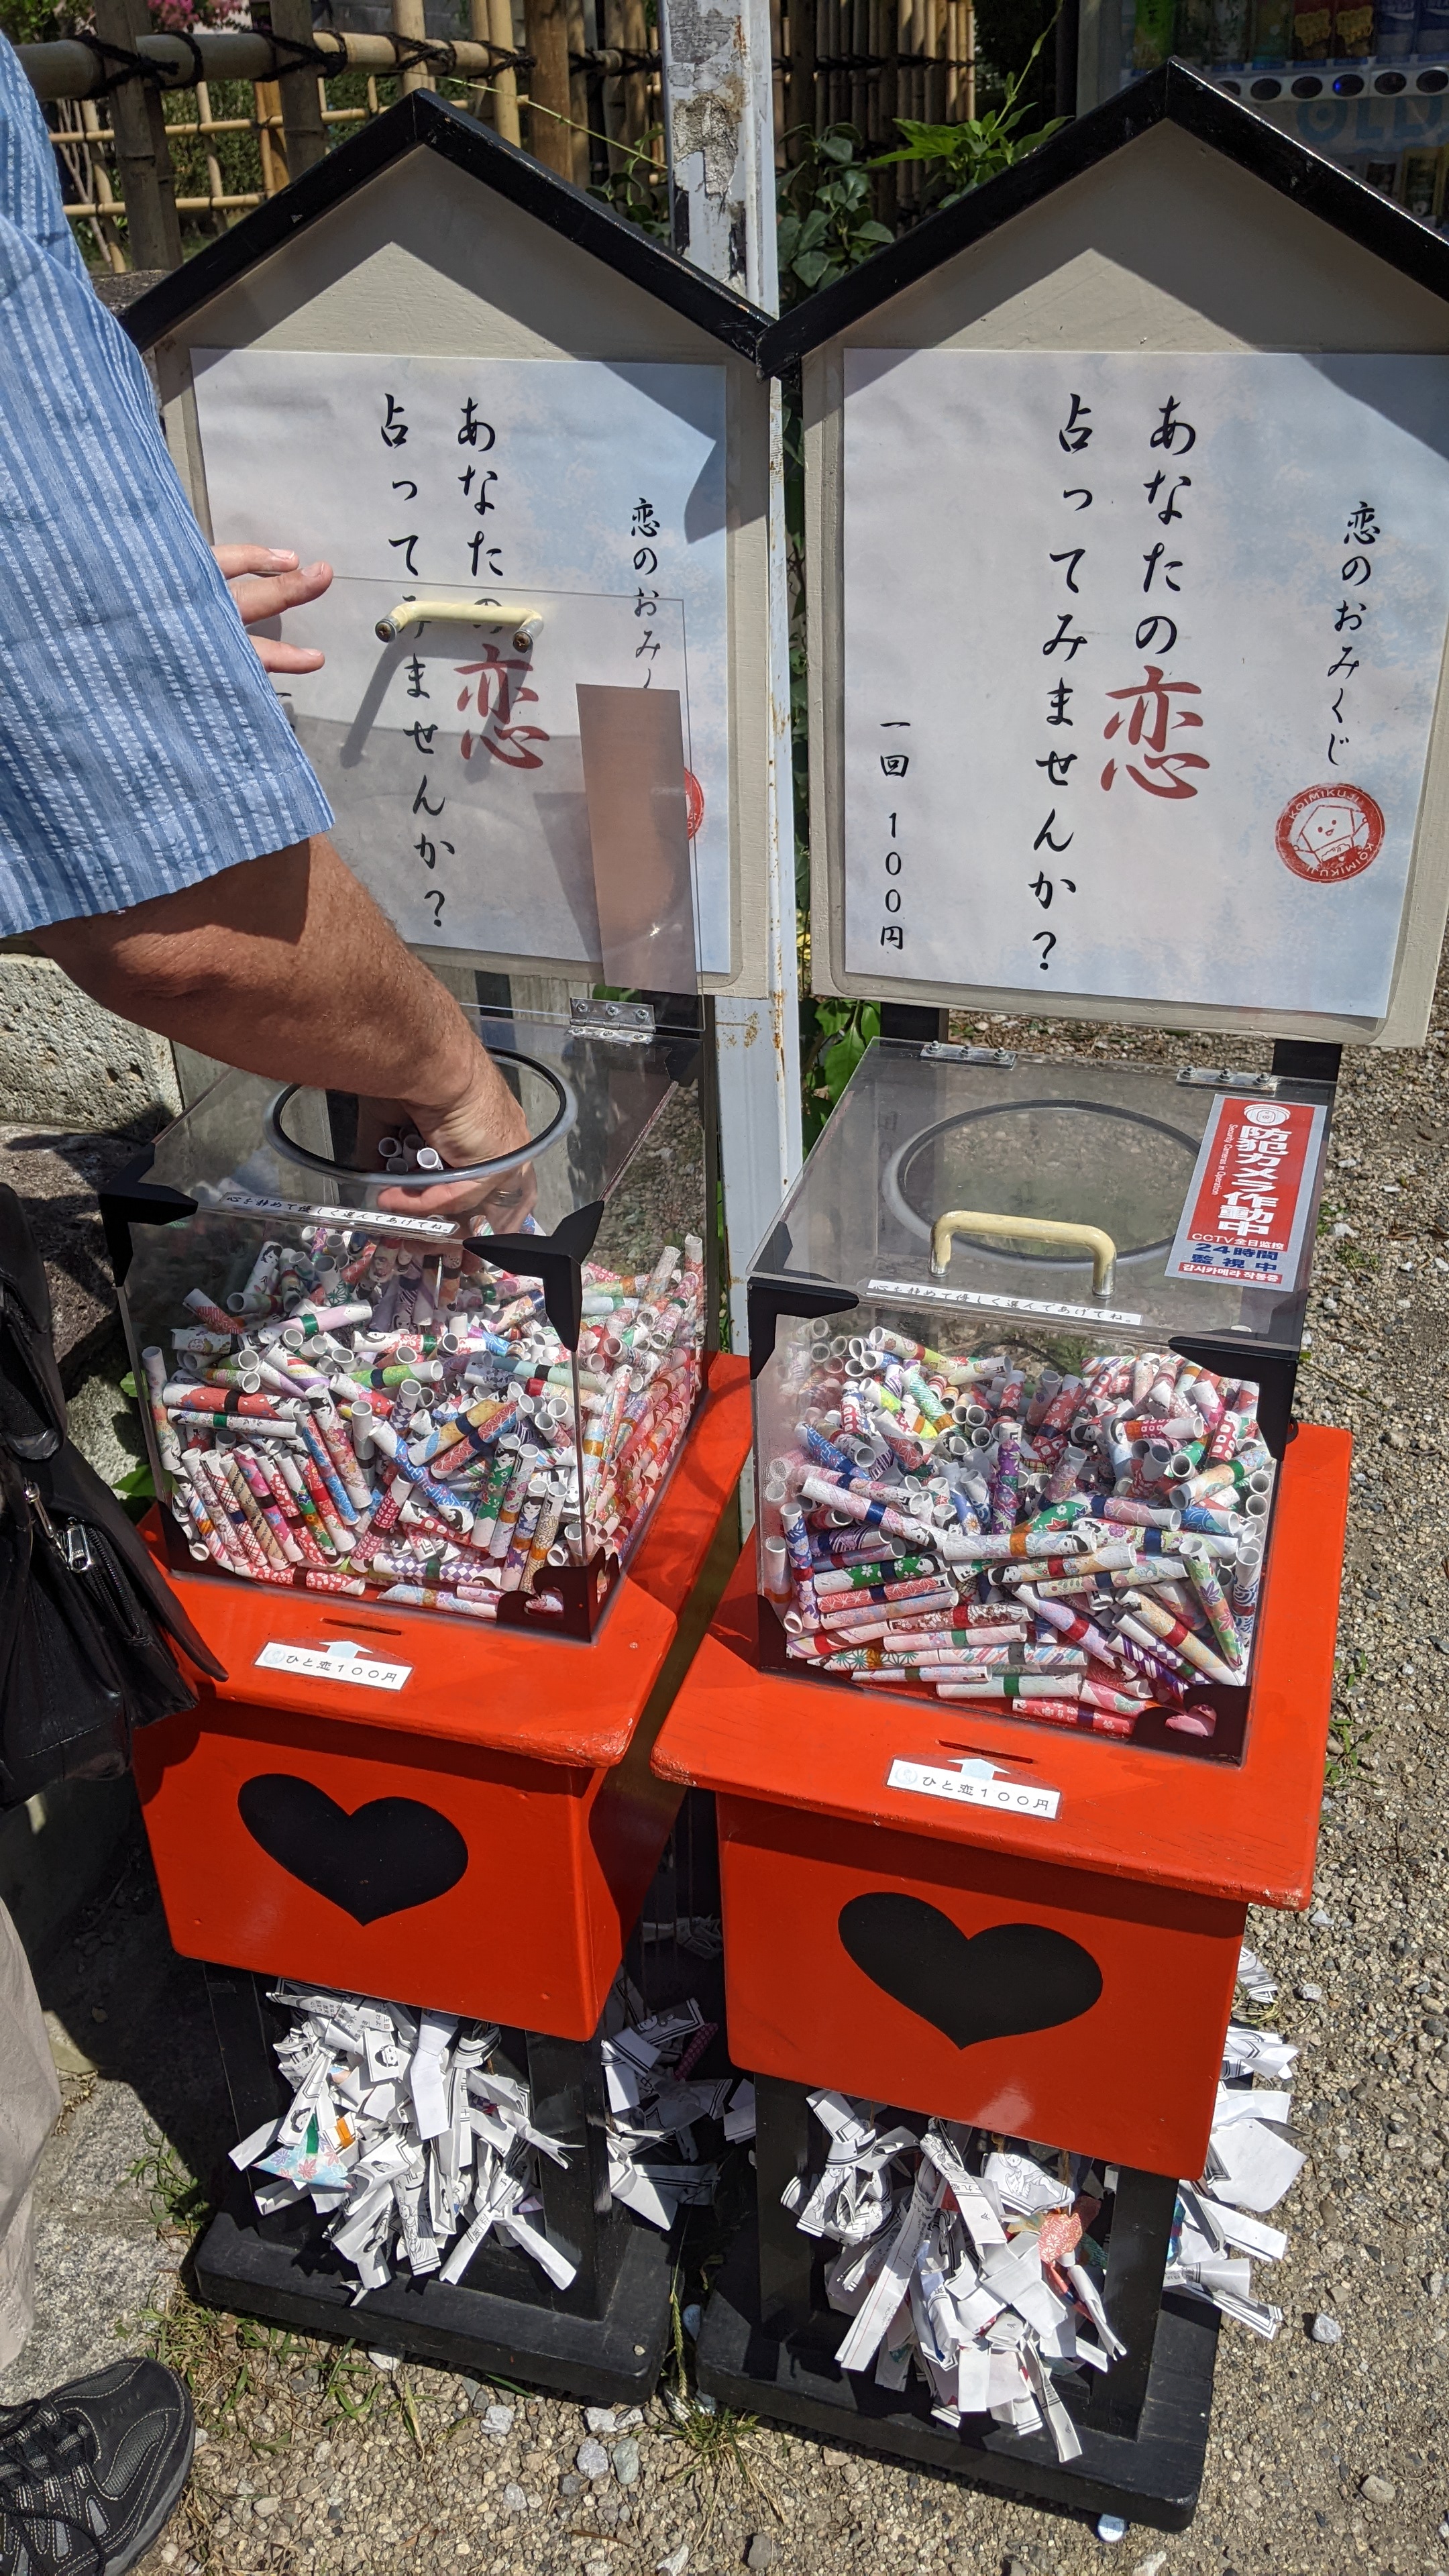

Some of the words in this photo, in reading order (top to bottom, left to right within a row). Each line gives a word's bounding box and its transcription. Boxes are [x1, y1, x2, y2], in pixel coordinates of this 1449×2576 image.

[1327, 501, 1381, 766] 恋のおみくじ
[1289, 790, 1360, 820] KOIMIKUJI
[1224, 1124, 1238, 1143] Security
[1219, 1144, 1233, 1165] Cameras
[1211, 1171, 1226, 1195] Operation
[1218, 1125, 1292, 1236] 防犯カメラ作動中
[1194, 1243, 1279, 1260] 24時間
